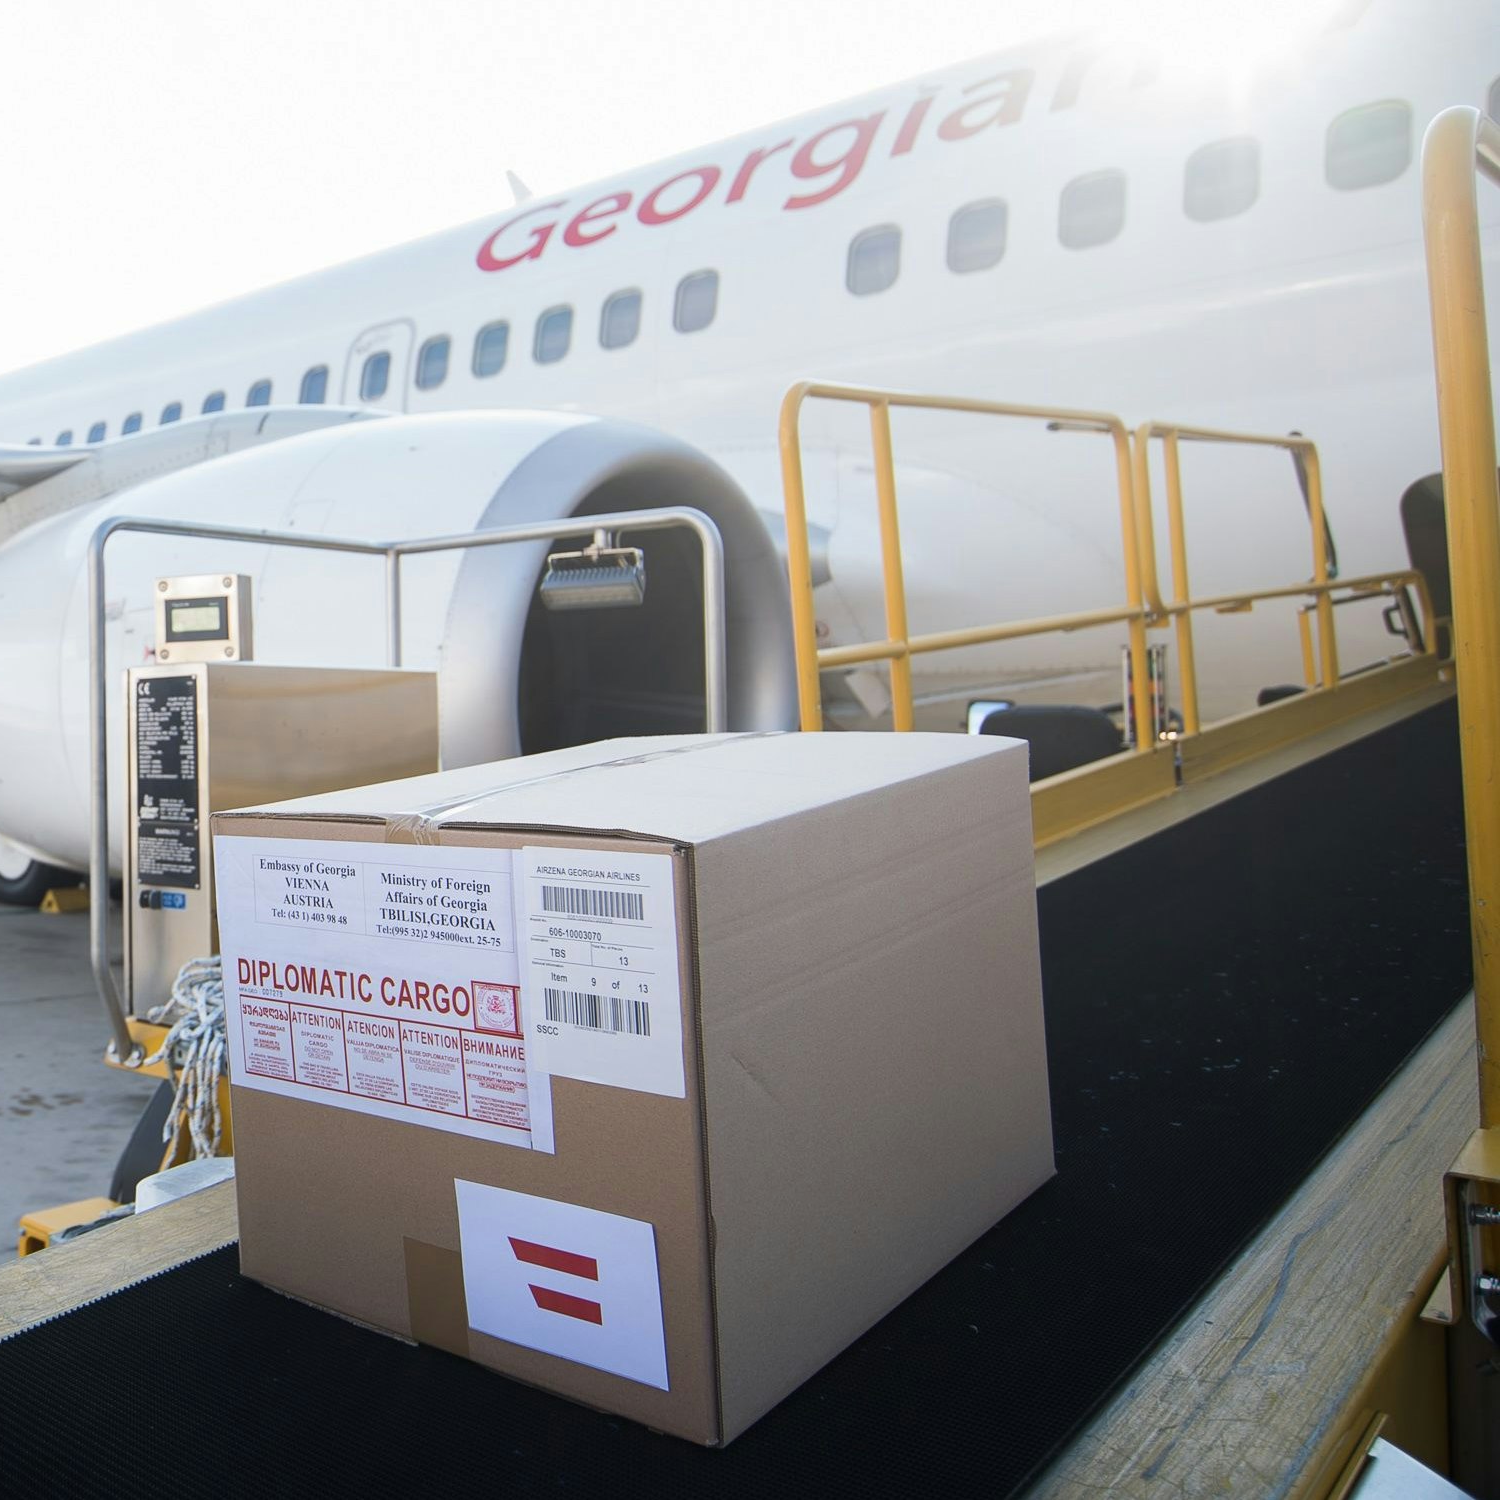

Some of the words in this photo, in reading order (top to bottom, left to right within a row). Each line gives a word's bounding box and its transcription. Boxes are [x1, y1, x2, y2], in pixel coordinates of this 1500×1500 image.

[260, 858, 301, 875] Embassy
[303, 862, 314, 873] of
[316, 862, 356, 879] Georgia
[536, 865, 566, 876] AIRZENA
[567, 868, 605, 879] GEORGIAN
[606, 871, 641, 882] AIRLINES
[285, 877, 329, 892] VIENNA
[380, 872, 428, 890] Ministry
[431, 877, 443, 889] of
[446, 877, 491, 895] Foreign
[283, 893, 334, 909] AUSTRIA
[385, 891, 423, 906] Affairs
[426, 895, 438, 906] of
[440, 895, 488, 913] Georgia
[271, 908, 286, 918] Tel:
[288, 910, 300, 920] (43
[302, 911, 309, 922] 1)
[311, 913, 325, 923] 403
[327, 914, 336, 924] 98
[338, 915, 348, 925] 48
[379, 907, 496, 932] TBILISI,GEORGIA
[376, 924, 409, 937] Tel:(995
[411, 928, 428, 939] 32)2
[430, 931, 475, 944] 945000ext.
[477, 935, 501, 947] 25-75
[549, 927, 602, 941] 606-10003070
[550, 948, 566, 959] TBS
[619, 956, 629, 966] 13
[237, 957, 373, 1003] DIPLOMATIC
[380, 976, 471, 1017] CARGO
[550, 972, 568, 983] Item
[591, 977, 597, 987] 9
[612, 980, 620, 990] of
[638, 984, 649, 994] 13
[242, 1003, 289, 1021] ყურადღება
[291, 1011, 341, 1030] ATTENTION
[301, 1030, 335, 1042] DIPLOMATIC
[347, 1020, 395, 1039] ATENCION
[536, 1024, 559, 1036] SSCC
[308, 1040, 328, 1048] CARGO
[402, 1028, 459, 1050] ATTENTION
[403, 1048, 422, 1058] VALISE
[422, 1051, 461, 1063] DIPLOMATIQUE
[463, 1038, 525, 1061] ВНИМАНИЕ
